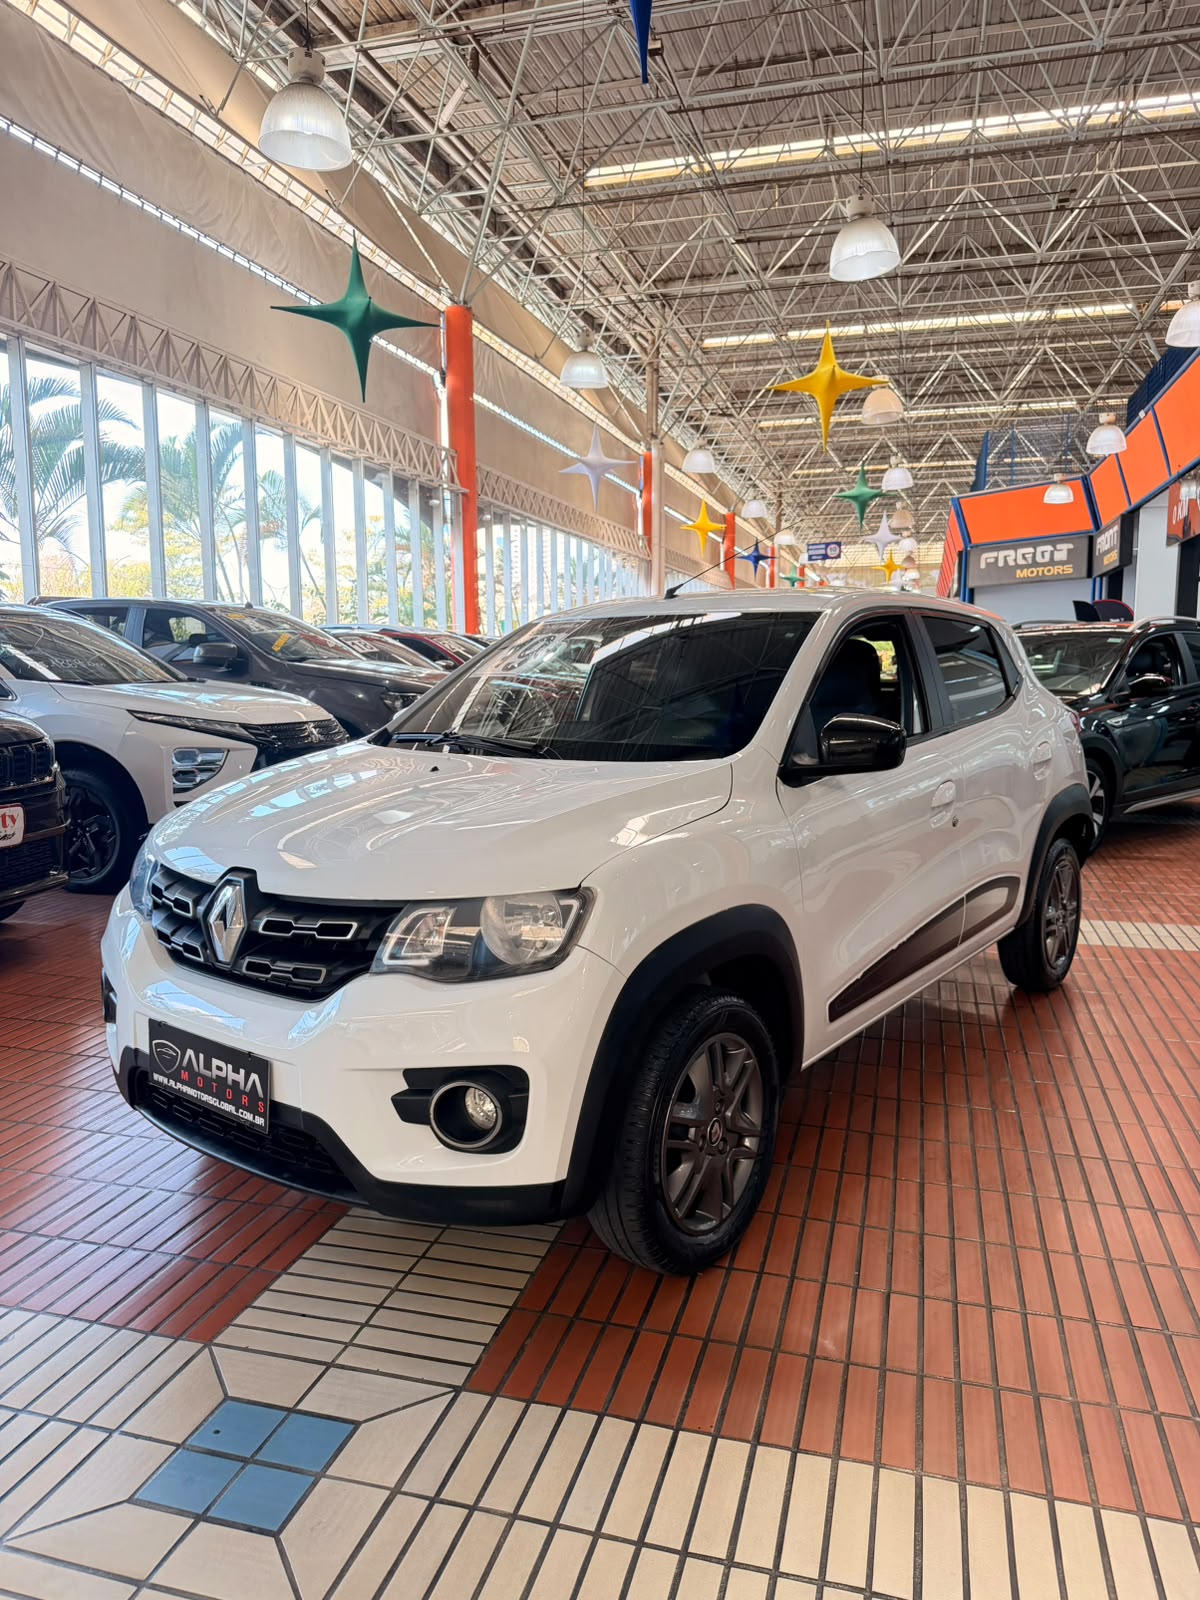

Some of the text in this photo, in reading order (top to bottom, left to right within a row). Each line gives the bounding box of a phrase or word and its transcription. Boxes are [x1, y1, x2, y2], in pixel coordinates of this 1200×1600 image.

[1016, 564, 1073, 578] MOTORS
[181, 1048, 264, 1099] ALPHA
[181, 1070, 265, 1113] MOTORS
[153, 1072, 265, 1127] WWW.ALPHAMOTORSGLOBAL.COM.BR
